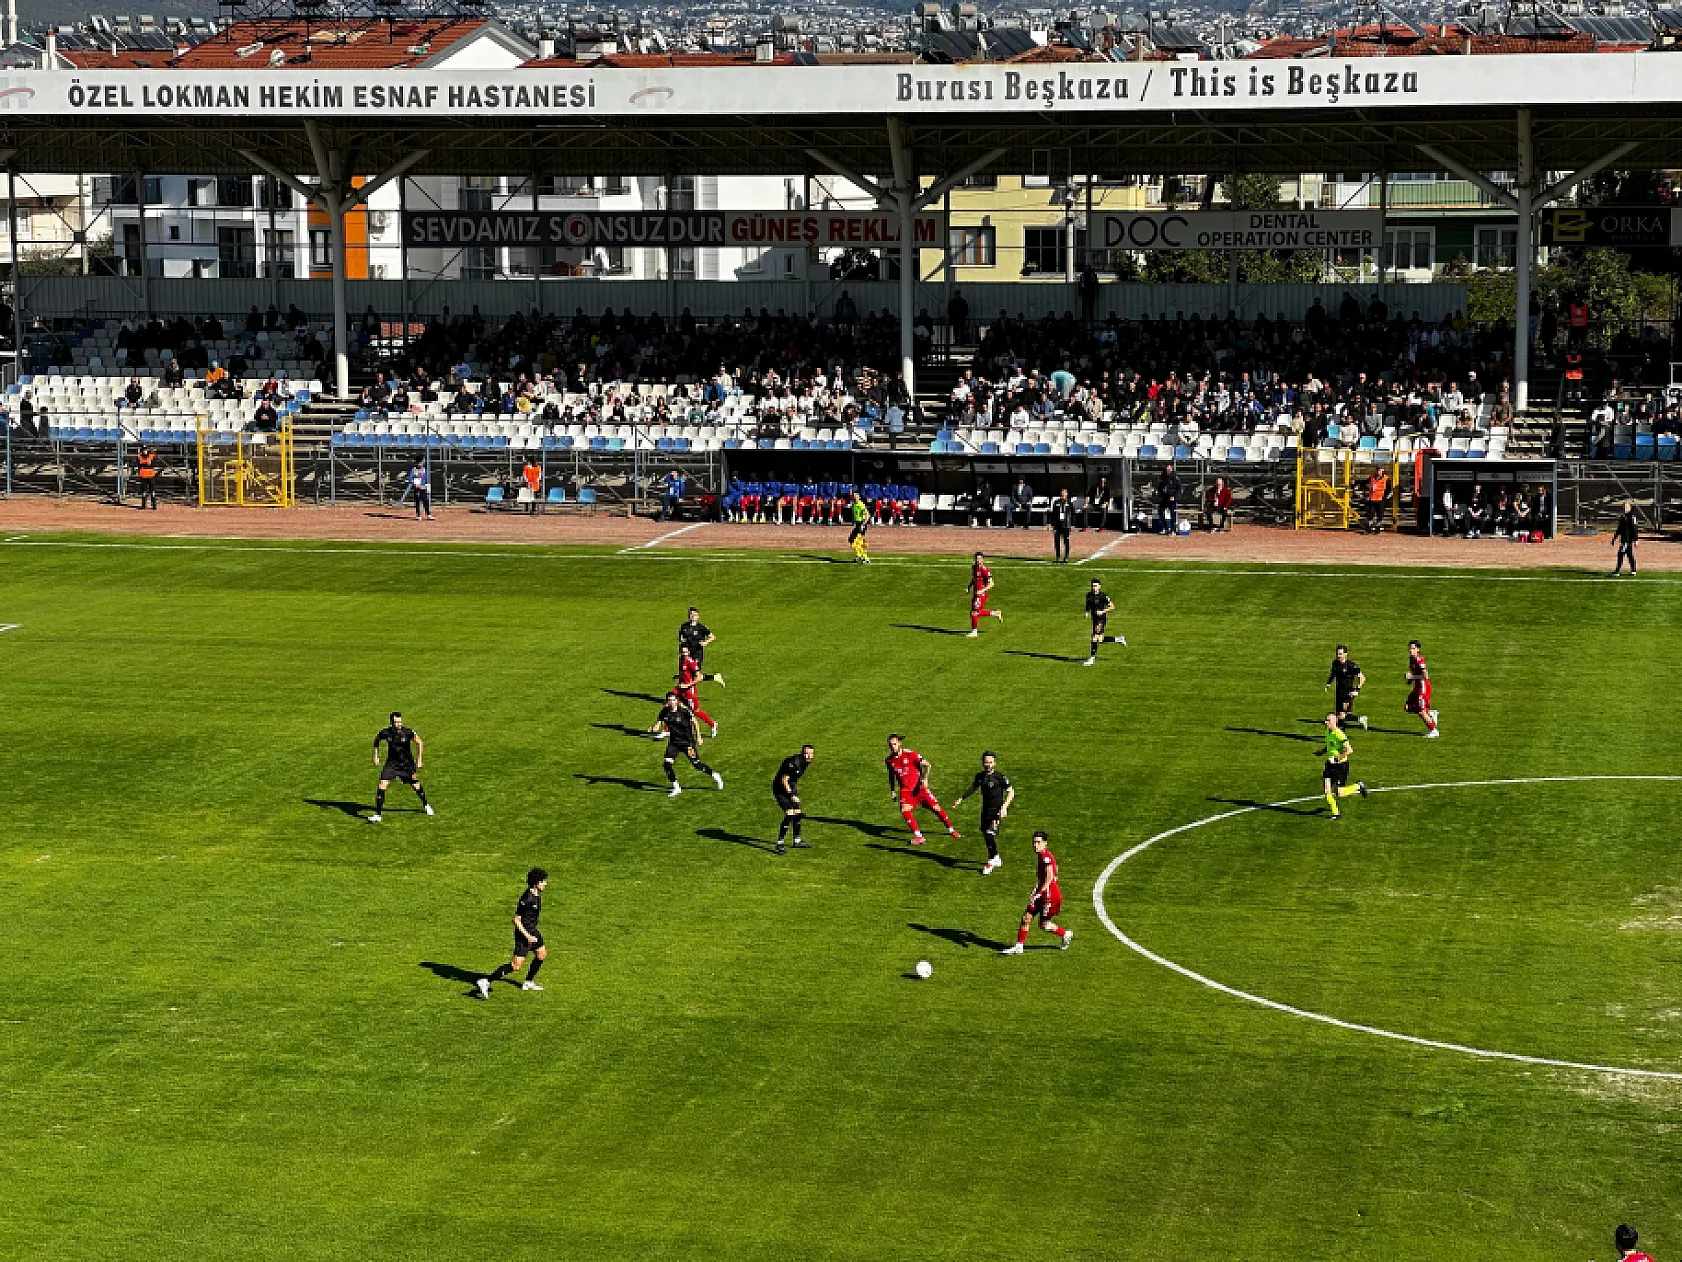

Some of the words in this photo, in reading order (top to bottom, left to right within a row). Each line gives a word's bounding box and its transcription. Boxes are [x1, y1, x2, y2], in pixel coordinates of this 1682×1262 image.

[67, 78, 134, 108] ÖZEL
[142, 85, 251, 108] LOKMAN
[259, 78, 343, 108] HEKİM
[352, 85, 439, 108] ESNAF
[448, 78, 595, 108] HASTANESİ
[897, 73, 993, 102] Burası
[1004, 71, 1130, 109] Beşkaza
[1170, 68, 1236, 98] This
[1248, 65, 1275, 96] is
[1287, 65, 1419, 104] Beşkaza
[411, 216, 542, 242] SEVDAMIZ
[731, 213, 819, 246] GÜNEŞ
[1104, 215, 1189, 247] DOC
[1250, 214, 1320, 229] DENTAL
[1600, 215, 1665, 233] ORKA
[1197, 231, 1299, 246] OPERATION
[1304, 230, 1373, 246] CENTER
